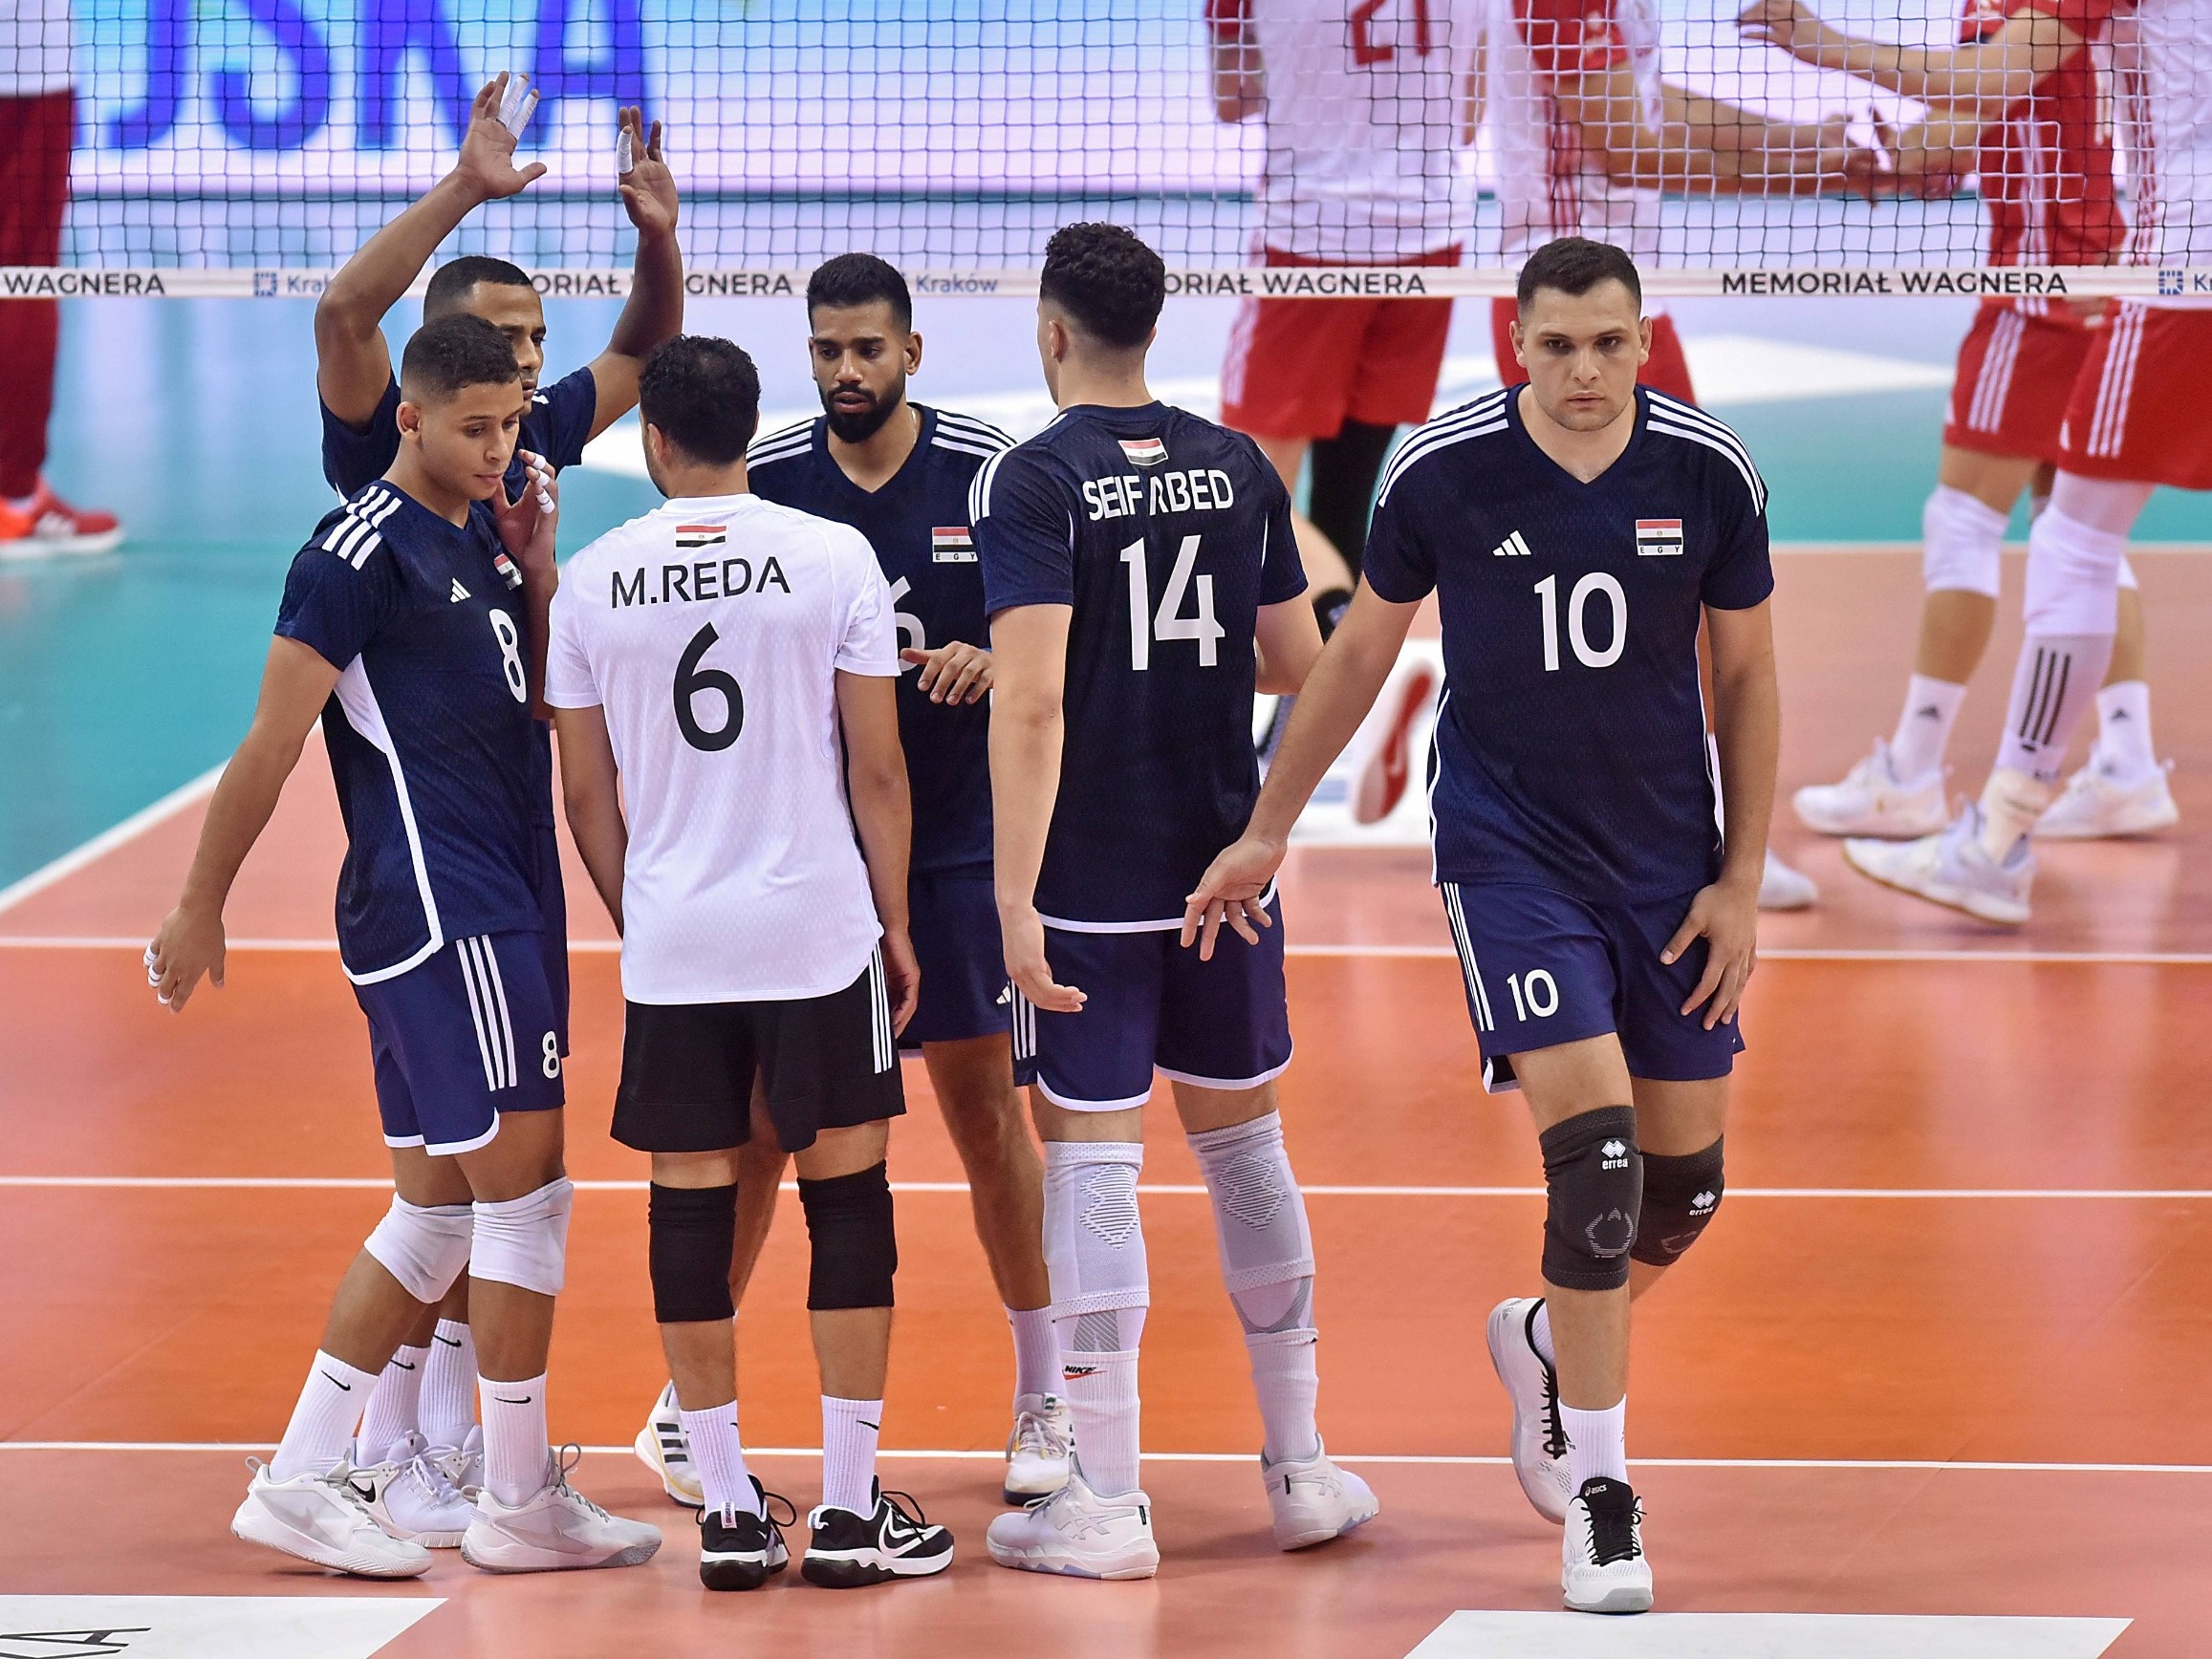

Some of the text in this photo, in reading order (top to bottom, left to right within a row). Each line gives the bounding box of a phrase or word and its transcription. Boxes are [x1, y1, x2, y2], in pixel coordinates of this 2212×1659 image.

[3, 272, 166, 295] WAGNERA
[531, 273, 792, 295] ORIAŁ GNERA
[916, 273, 998, 292] Kraków
[1164, 272, 1427, 295] ORIAŁ WAGNERA
[1722, 271, 2069, 294] MEMORIAŁ WAGNERA
[1082, 475, 1143, 522] SEIF
[611, 556, 792, 609] M.REDA
[1119, 534, 1225, 671] 14
[1533, 571, 1627, 671] 10
[488, 608, 527, 703] 8
[673, 621, 744, 752] 6
[1507, 968, 1559, 1022] 10
[542, 1030, 560, 1079] 8
[1601, 1156, 1629, 1171] errea
[1064, 1365, 1096, 1374] NIKE
